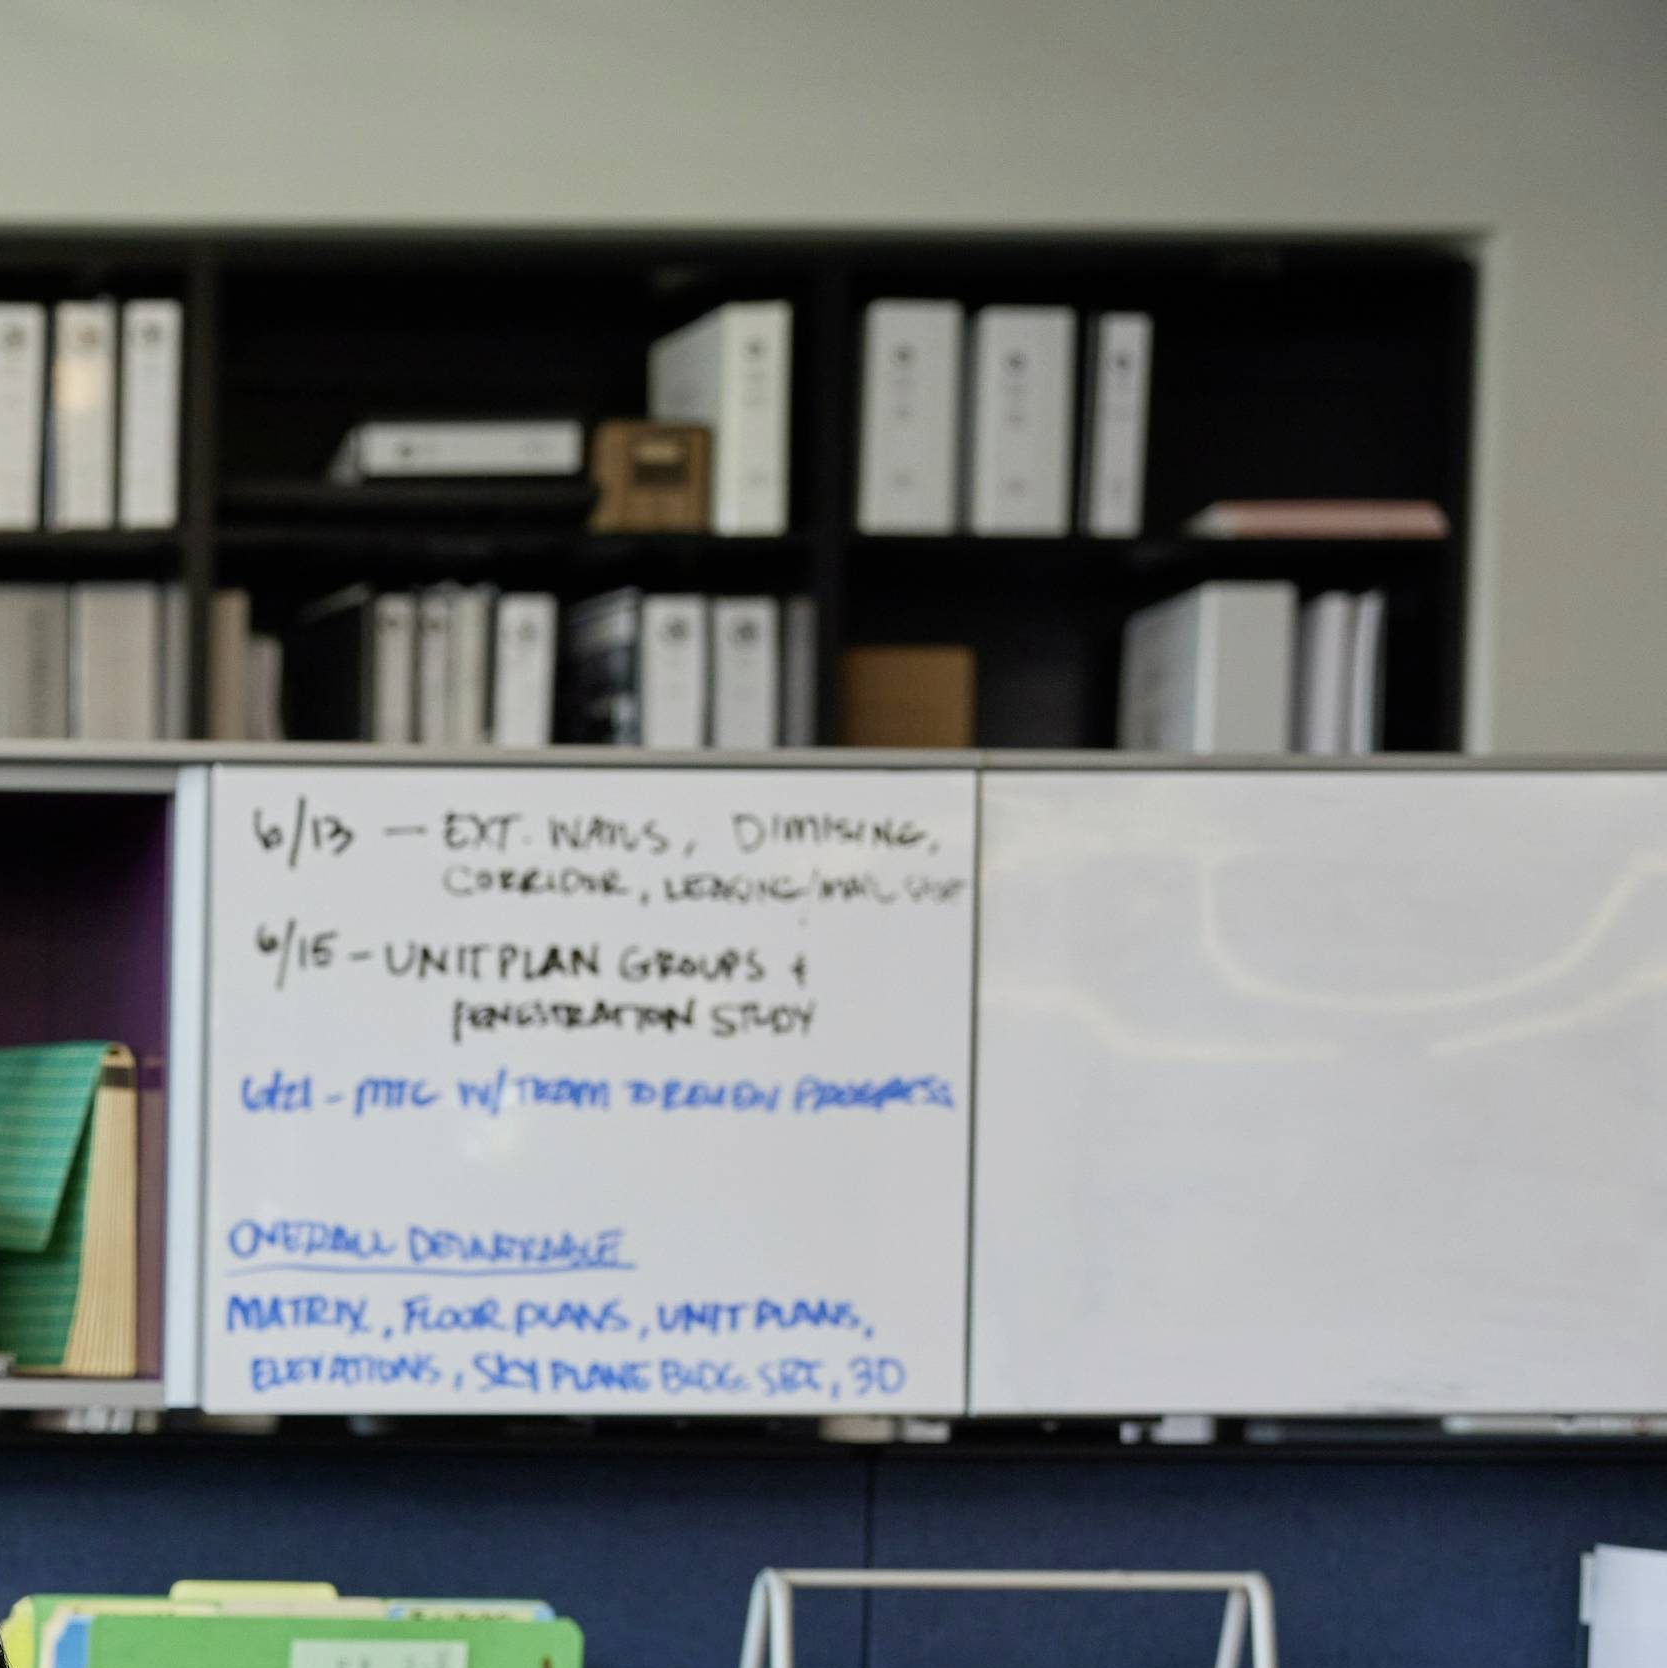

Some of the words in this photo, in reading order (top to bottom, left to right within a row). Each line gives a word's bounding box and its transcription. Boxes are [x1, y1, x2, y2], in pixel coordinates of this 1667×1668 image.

[253, 794, 356, 870] 6/13
[255, 916, 339, 992] 6/15
[618, 944, 766, 983] GROUPS
